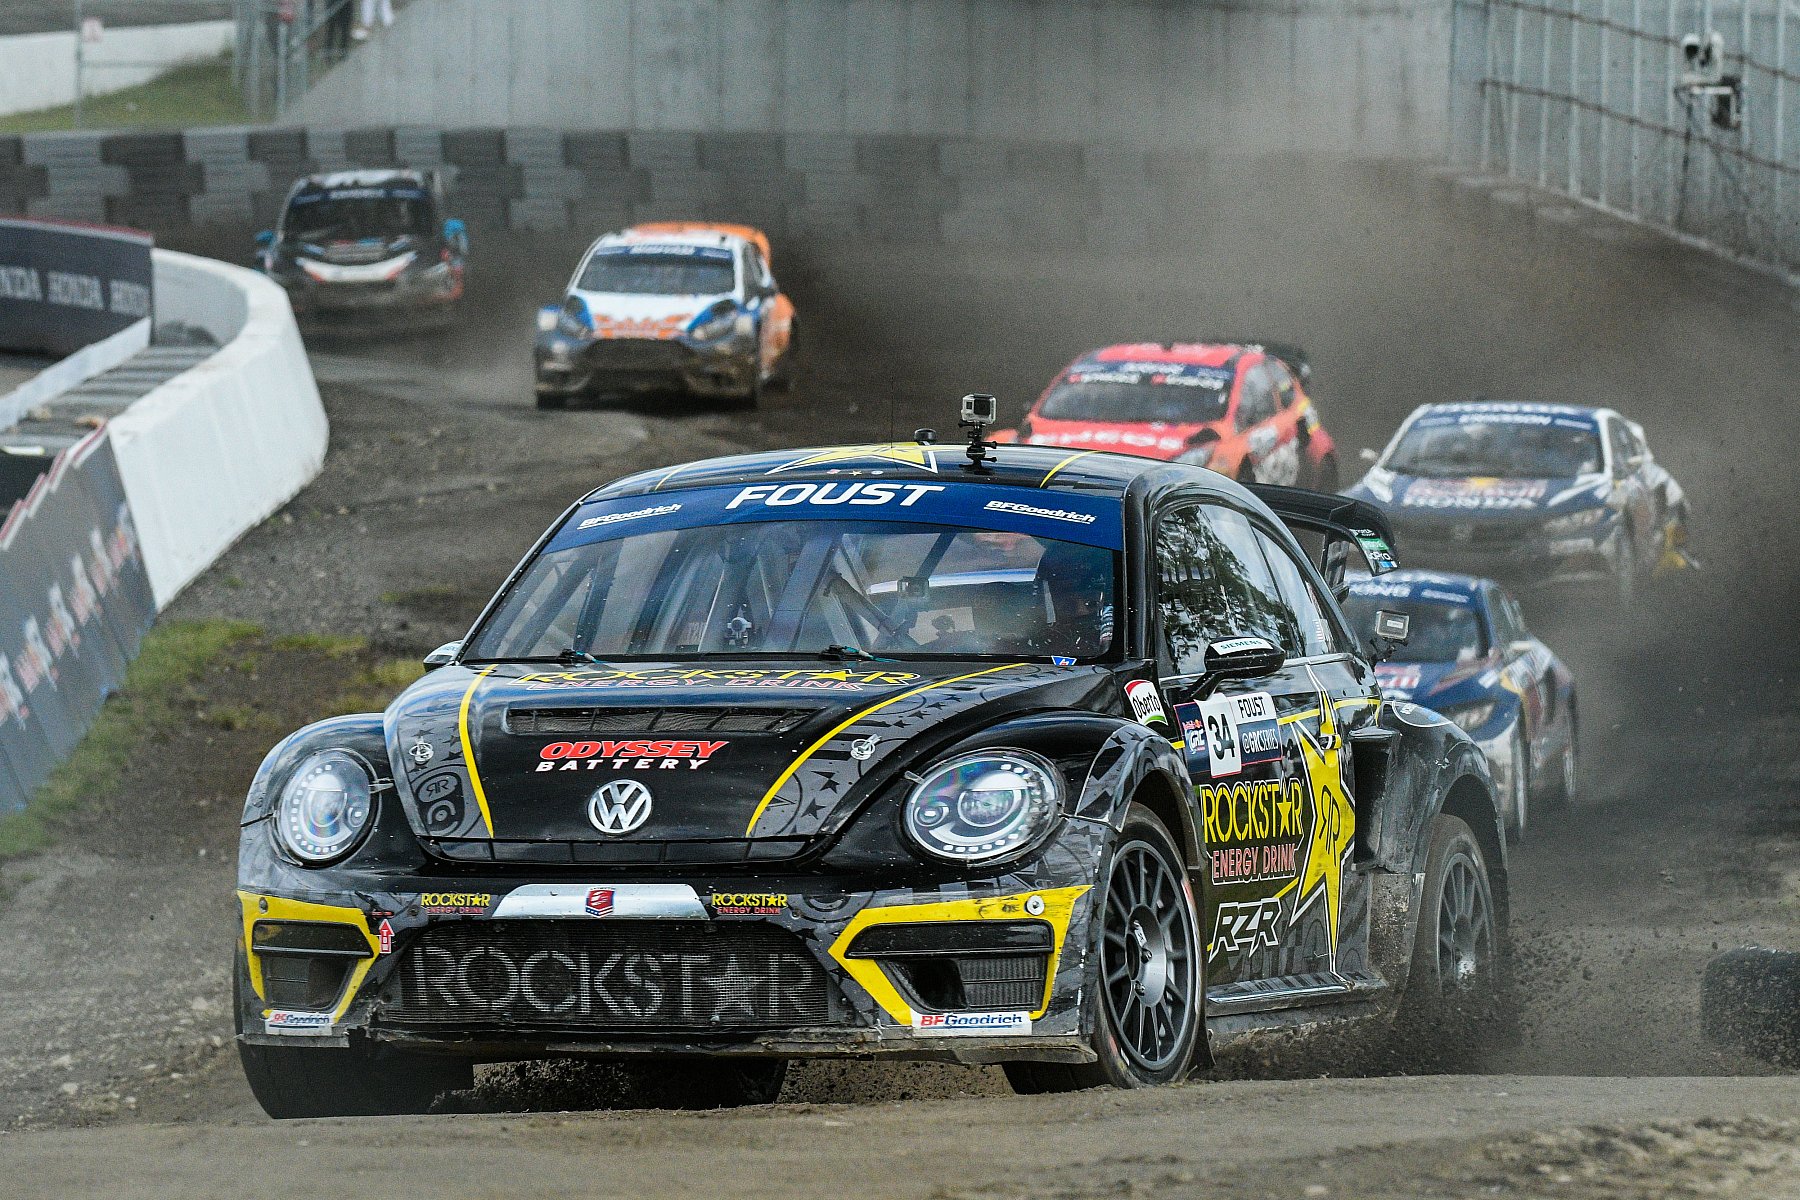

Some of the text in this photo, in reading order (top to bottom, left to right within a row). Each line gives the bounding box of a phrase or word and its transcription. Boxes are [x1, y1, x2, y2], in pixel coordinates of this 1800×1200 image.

[725, 482, 946, 509] FOUST
[578, 503, 682, 528] BFGoodrich
[986, 500, 1096, 523] BFGoodrich
[1220, 639, 1263, 650] SIEMENS
[1132, 691, 1161, 719] Oberto
[1237, 696, 1267, 719] FOUST
[1207, 714, 1235, 760] 34
[1242, 728, 1279, 754] @GRCSERIES
[539, 740, 730, 760] ODYSSEY
[535, 760, 709, 772] BATTERY
[1213, 843, 1295, 879] ENERGY DRINK
[1208, 898, 1282, 963] RZR
[921, 1014, 1022, 1027] BFGoodrich
